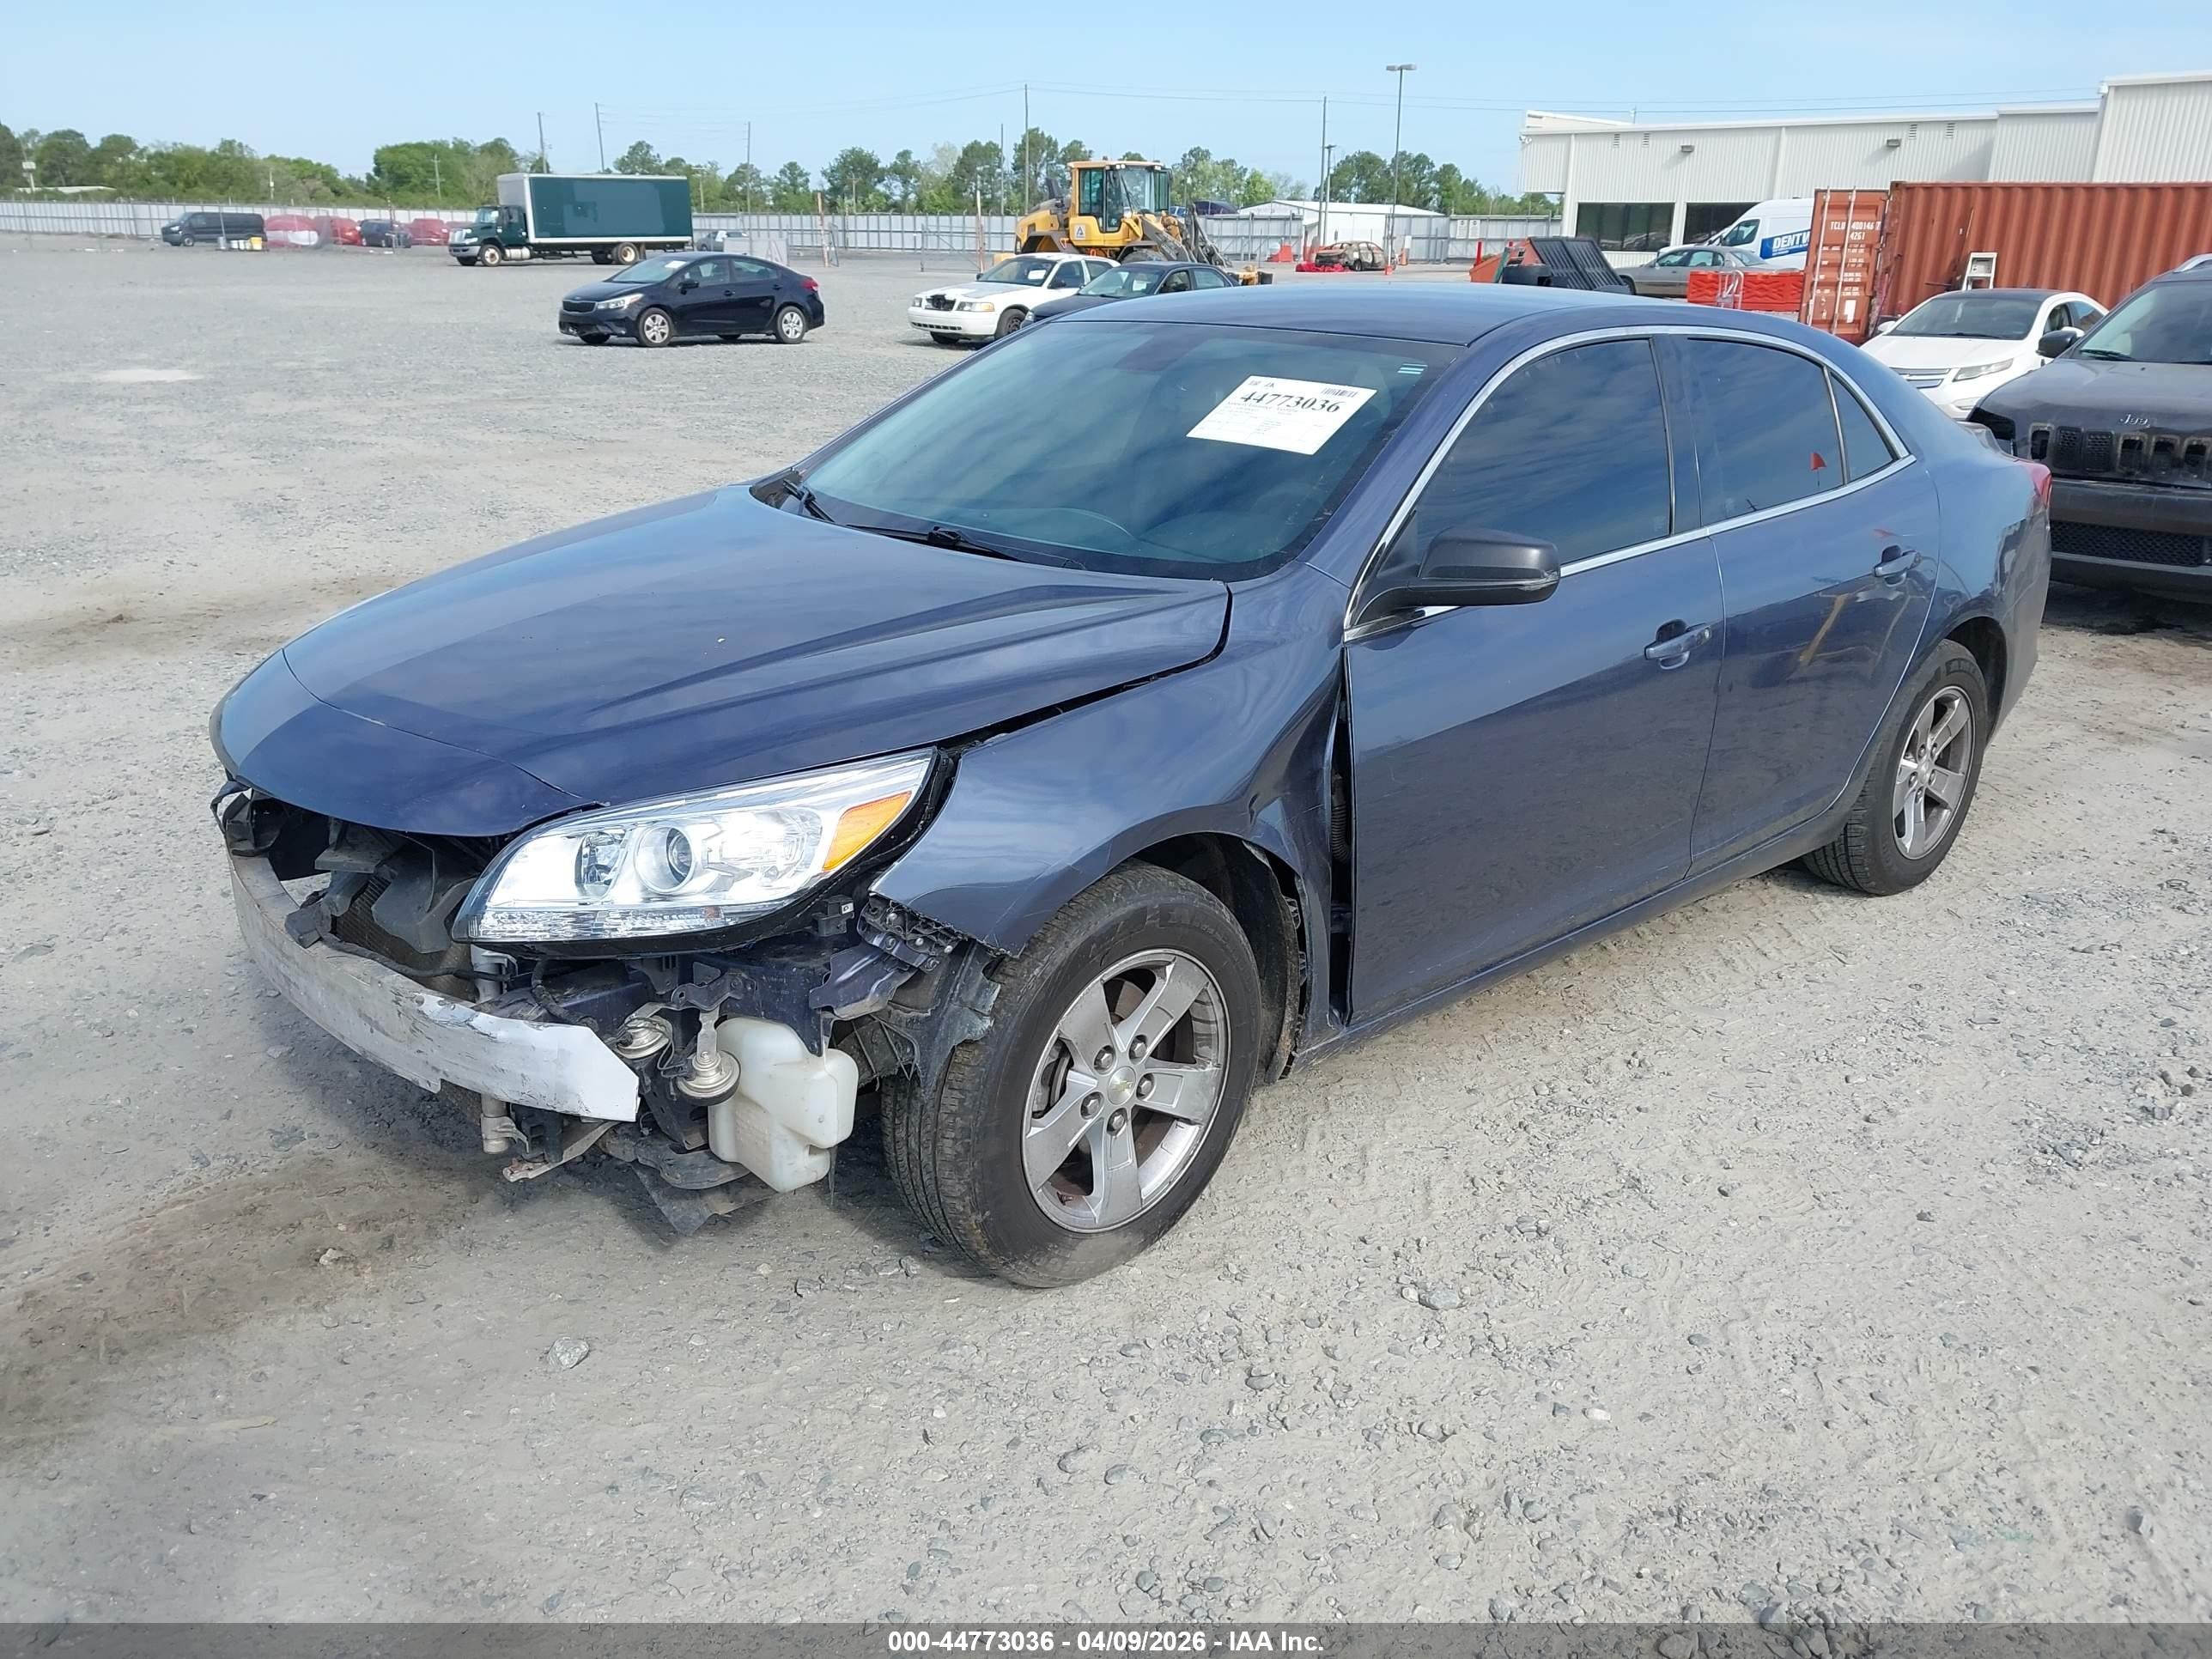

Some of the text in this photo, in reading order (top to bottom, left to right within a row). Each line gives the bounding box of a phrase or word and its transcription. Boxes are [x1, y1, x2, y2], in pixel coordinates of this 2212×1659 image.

[1830, 221, 1846, 230] TCLU
[1850, 221, 1875, 230] 400146
[1240, 390, 1346, 413] 44773036
